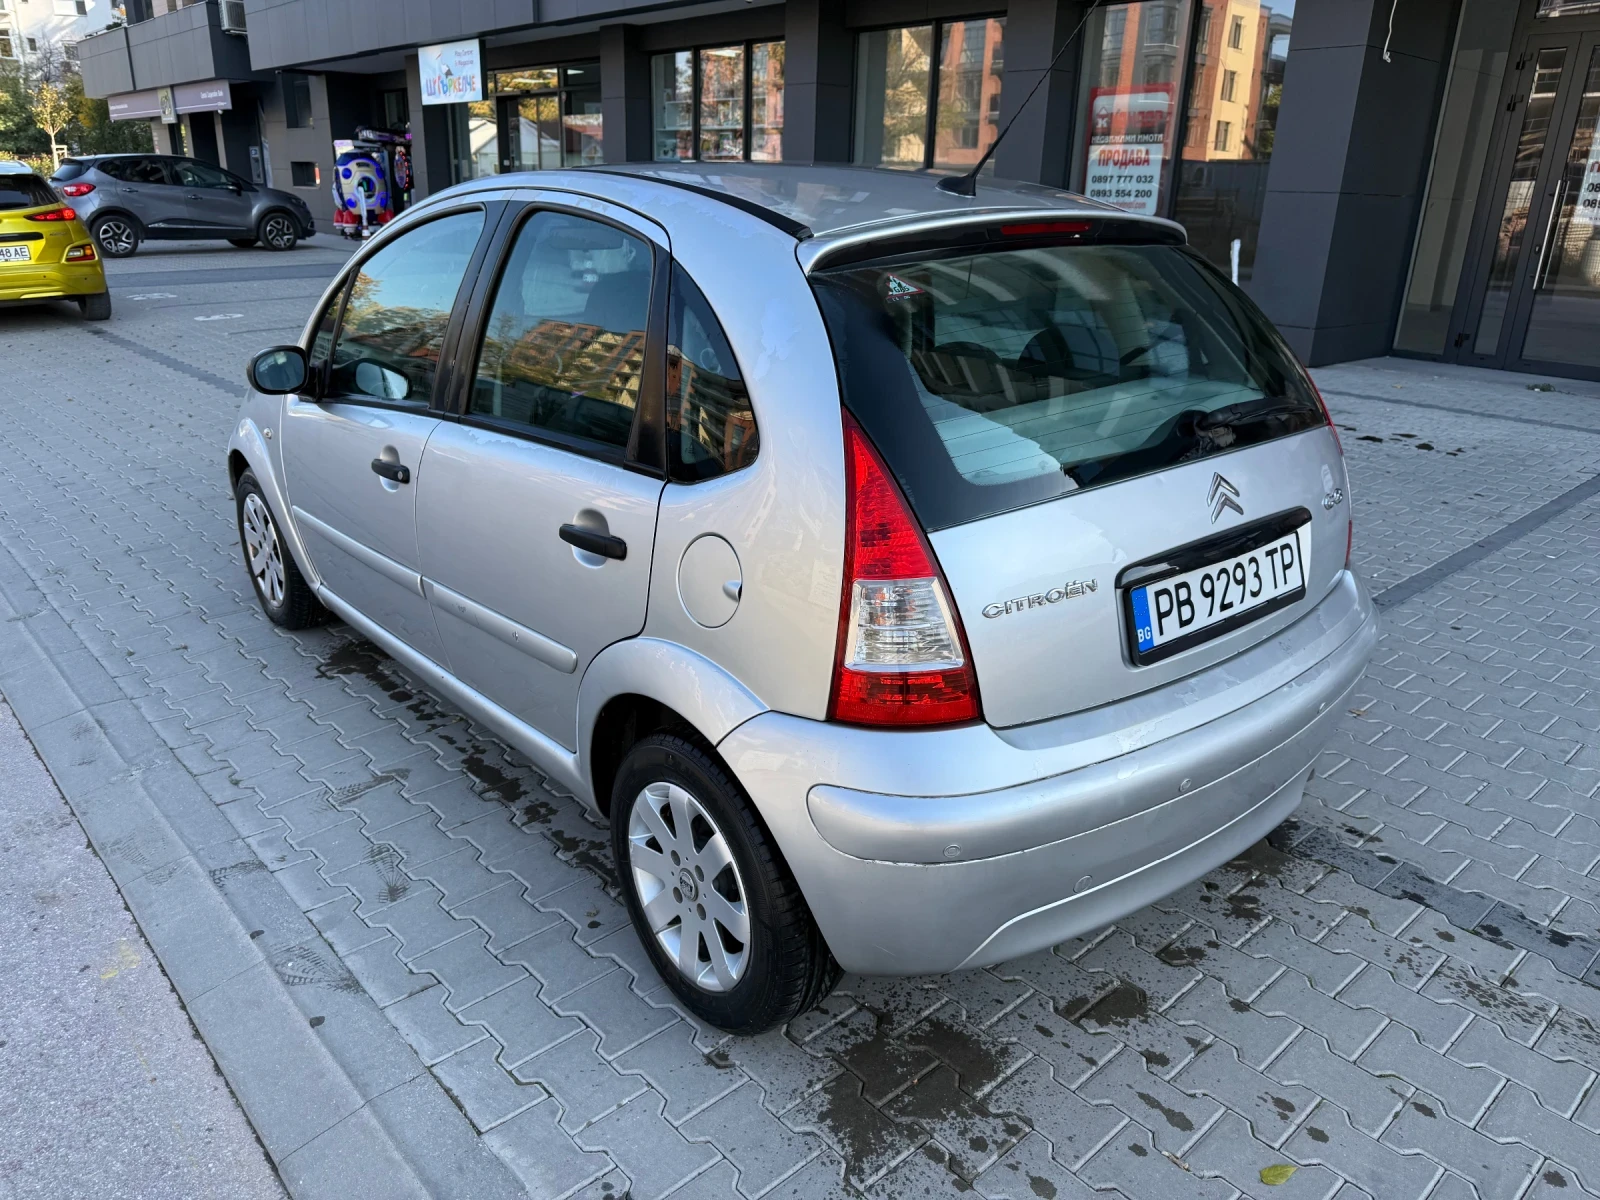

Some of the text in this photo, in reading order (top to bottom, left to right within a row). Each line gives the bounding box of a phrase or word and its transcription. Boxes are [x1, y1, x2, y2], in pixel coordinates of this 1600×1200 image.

[1137, 133, 1163, 142] ИМОТИ
[1098, 149, 1150, 170] ПРОДАВА
[1091, 175, 1154, 184] 0897 777 032
[1090, 189, 1152, 198] 0893 554 200
[14, 247, 29, 257] AE
[1154, 542, 1294, 636] PB 9293 TP
[981, 578, 1098, 619] CITROËN
[1137, 625, 1151, 644] BG
